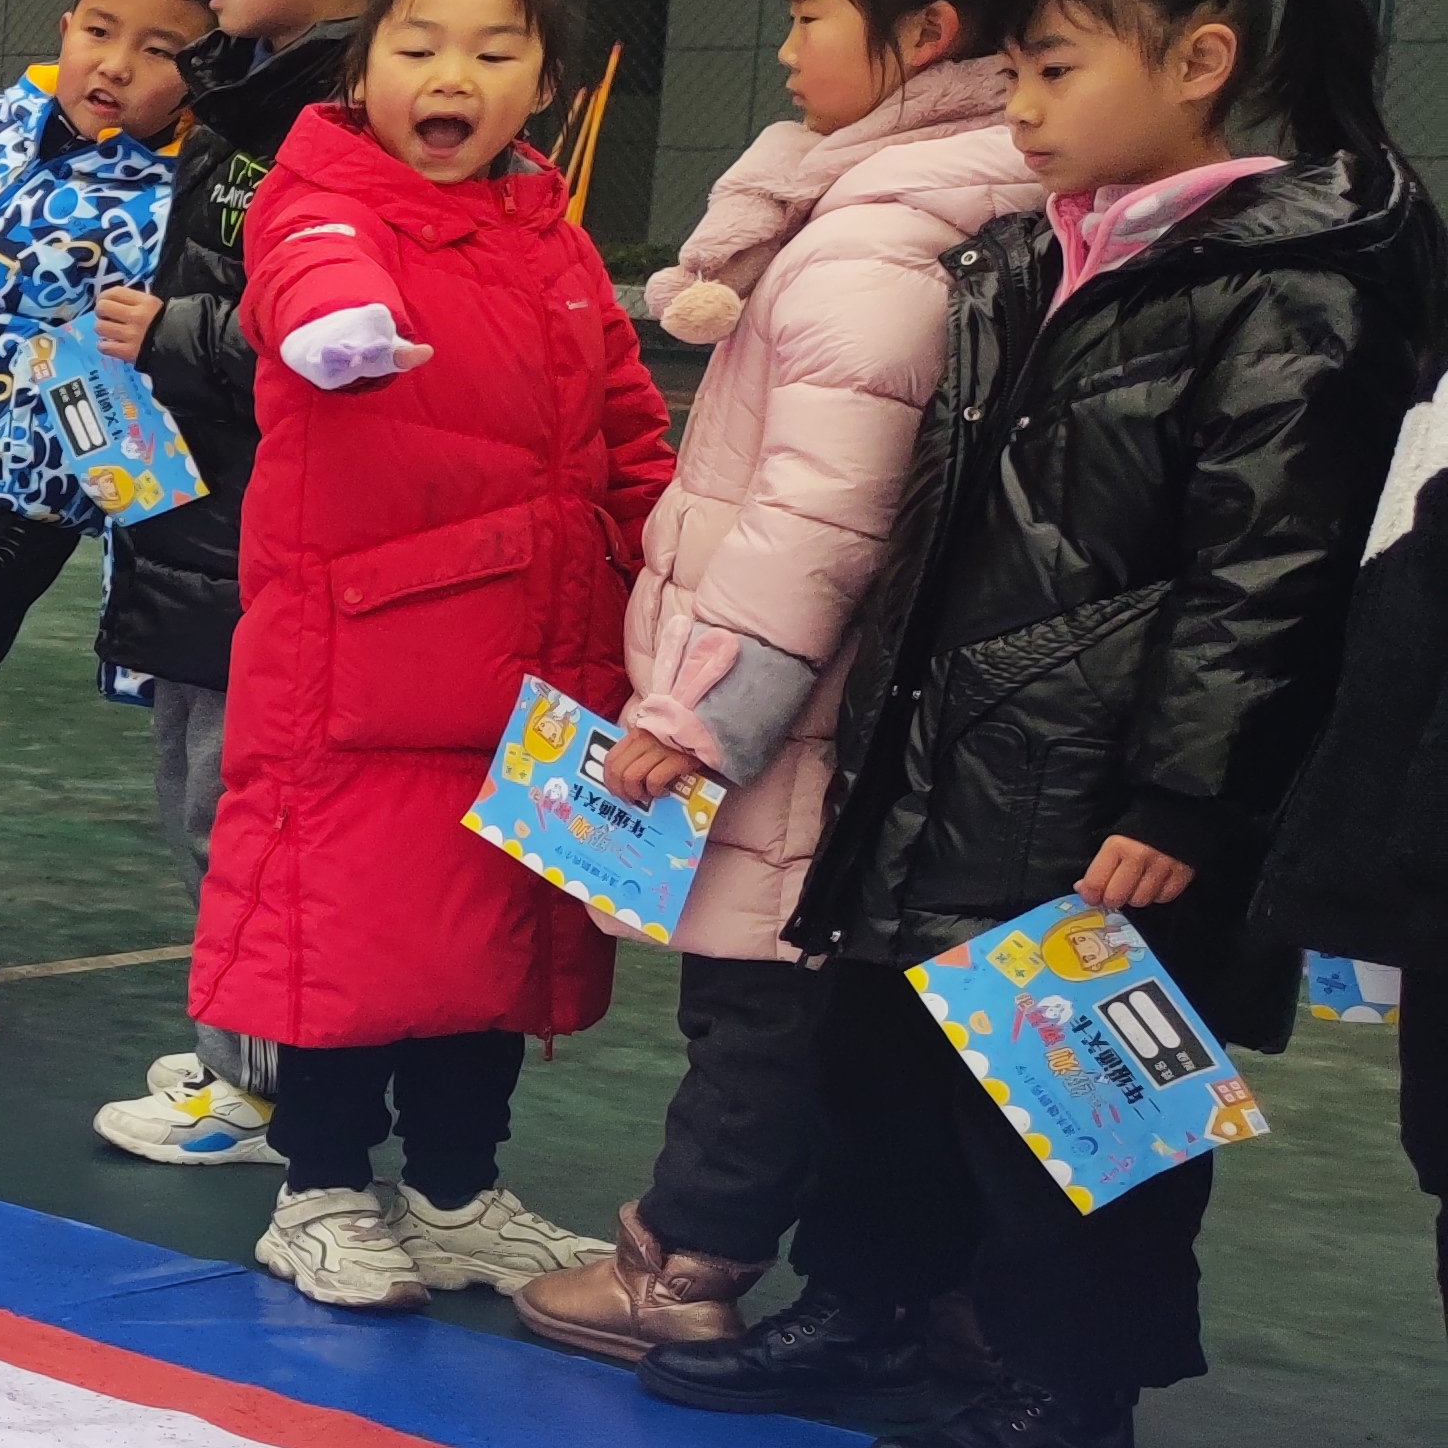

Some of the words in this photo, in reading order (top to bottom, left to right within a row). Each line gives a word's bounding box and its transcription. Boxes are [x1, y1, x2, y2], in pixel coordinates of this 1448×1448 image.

[1067, 1012, 1161, 1123] 二年级通关卡
